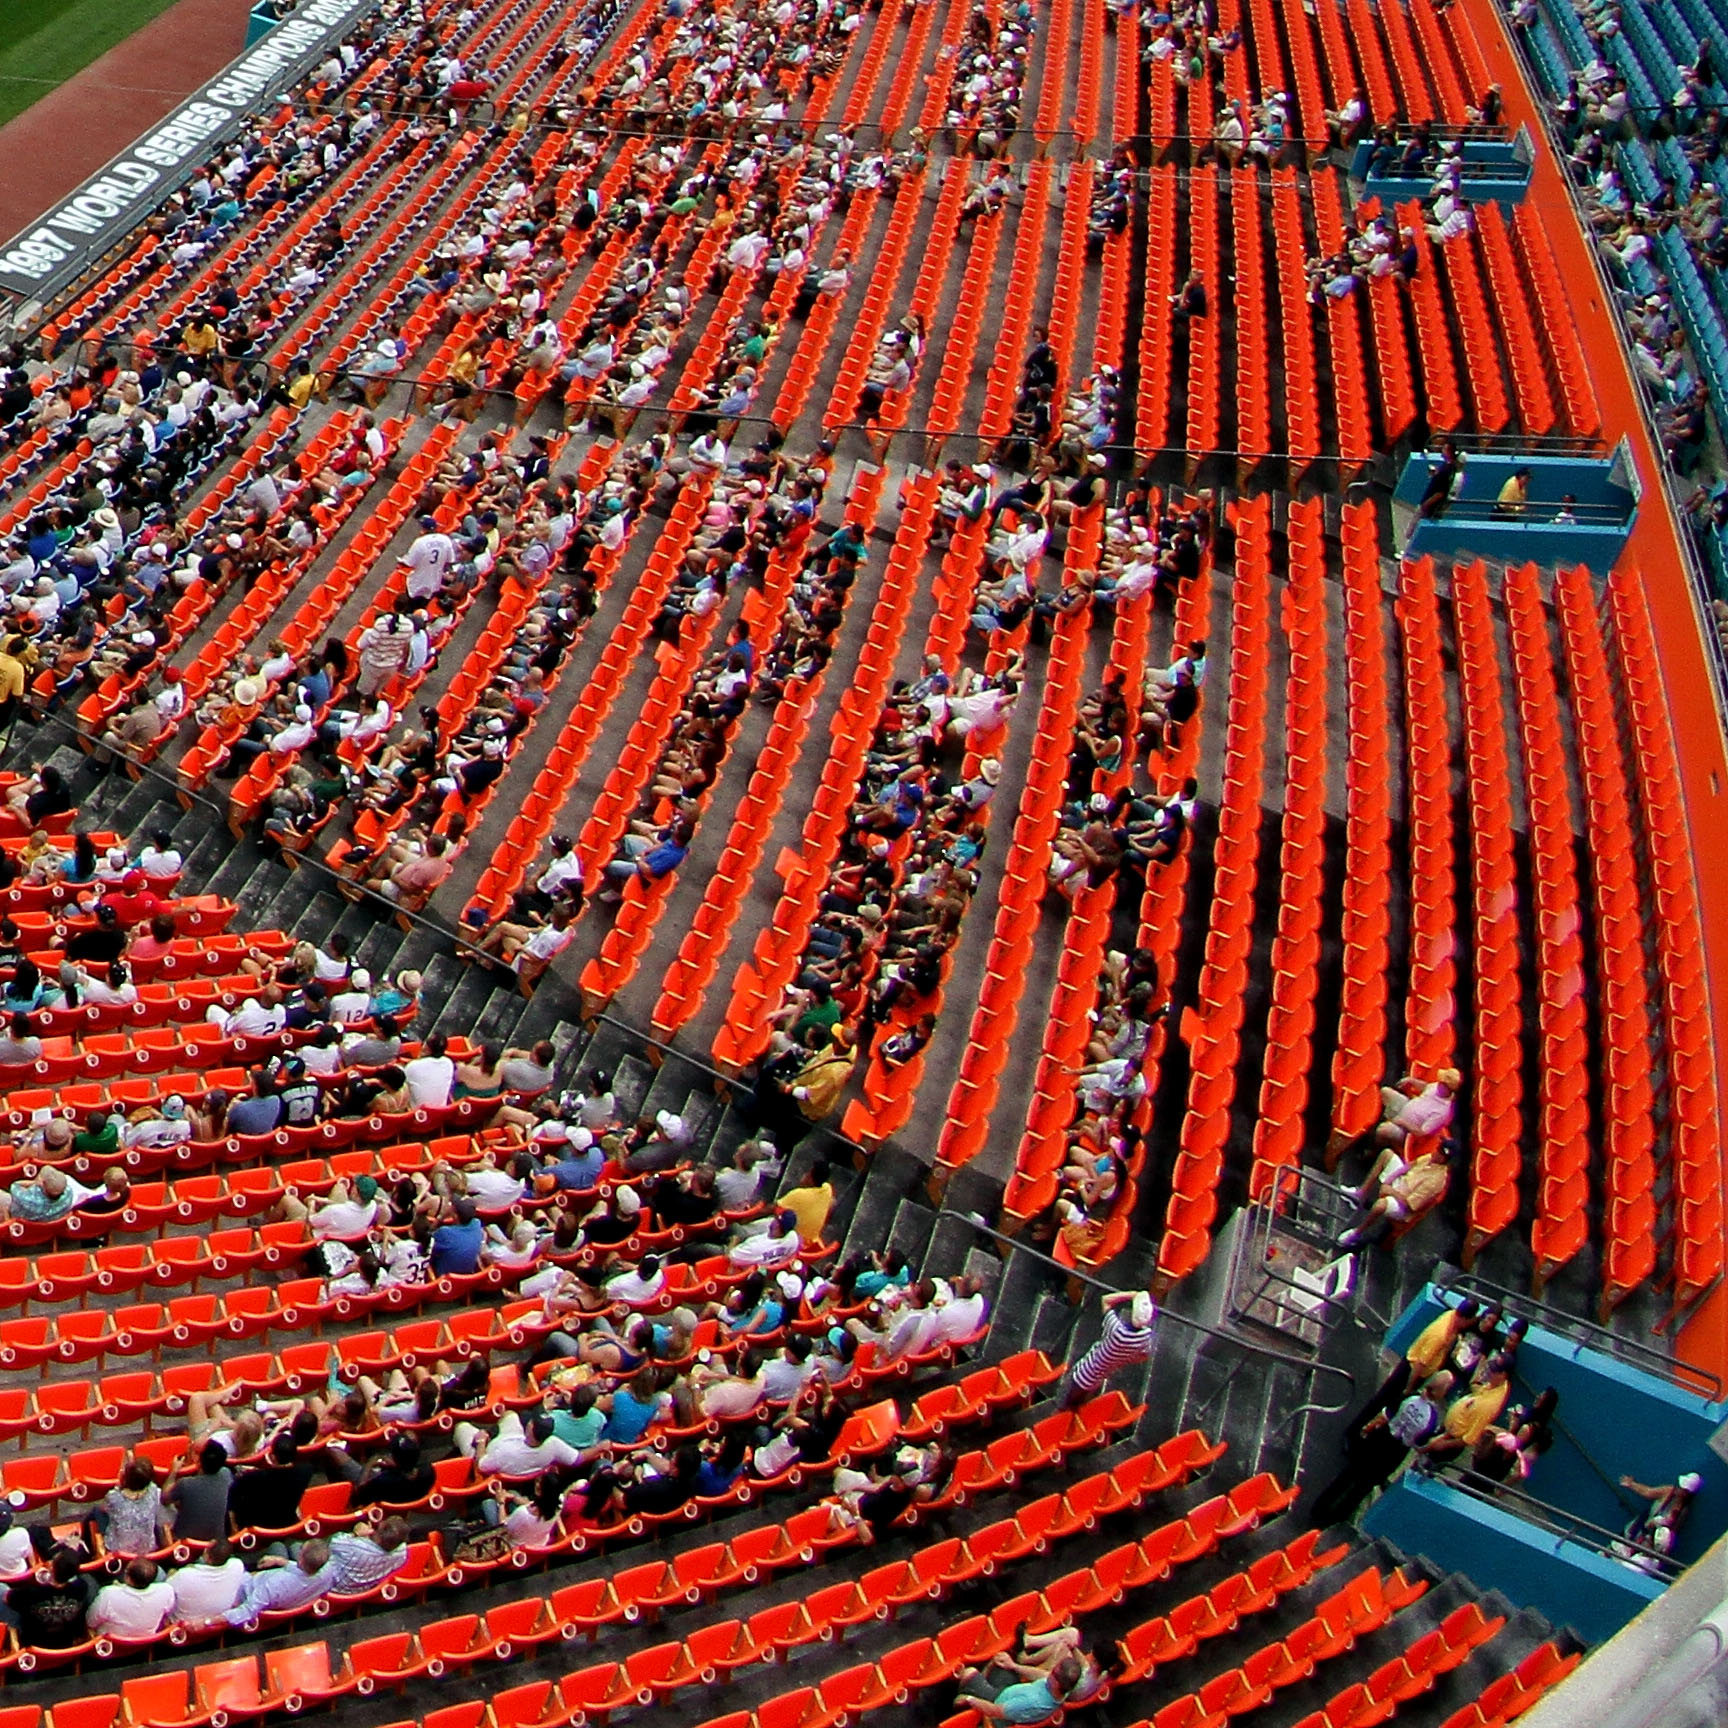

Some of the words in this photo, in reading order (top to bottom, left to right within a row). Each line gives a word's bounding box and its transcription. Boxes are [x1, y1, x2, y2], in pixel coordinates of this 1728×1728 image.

[49, 160, 161, 236] WORLD
[134, 103, 232, 170] SERIES
[206, 20, 329, 108] CHAMPIONS
